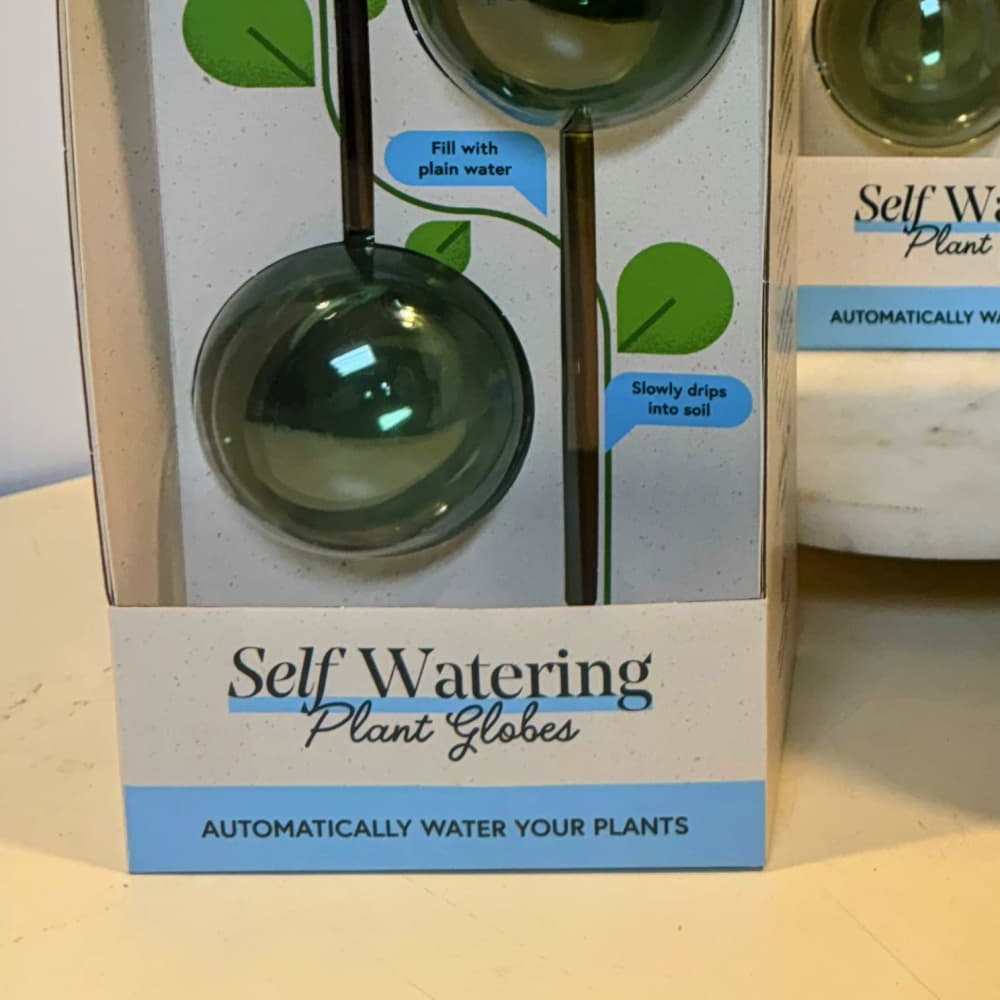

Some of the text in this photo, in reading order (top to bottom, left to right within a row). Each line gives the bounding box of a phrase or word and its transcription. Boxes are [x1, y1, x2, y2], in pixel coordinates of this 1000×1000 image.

[431, 141, 498, 155] Fill with
[418, 161, 512, 179] plain water
[855, 182, 936, 234] Self
[904, 224, 992, 259] Plant
[830, 310, 974, 325] AUTOMATICALLY
[632, 381, 727, 400] Slowly drips
[648, 402, 711, 418] into soil
[228, 646, 653, 715] Self Watering
[305, 700, 581, 762] Plant Globes
[202, 816, 689, 839] AUTOMATICALLY WATER YOUR PLANTS
